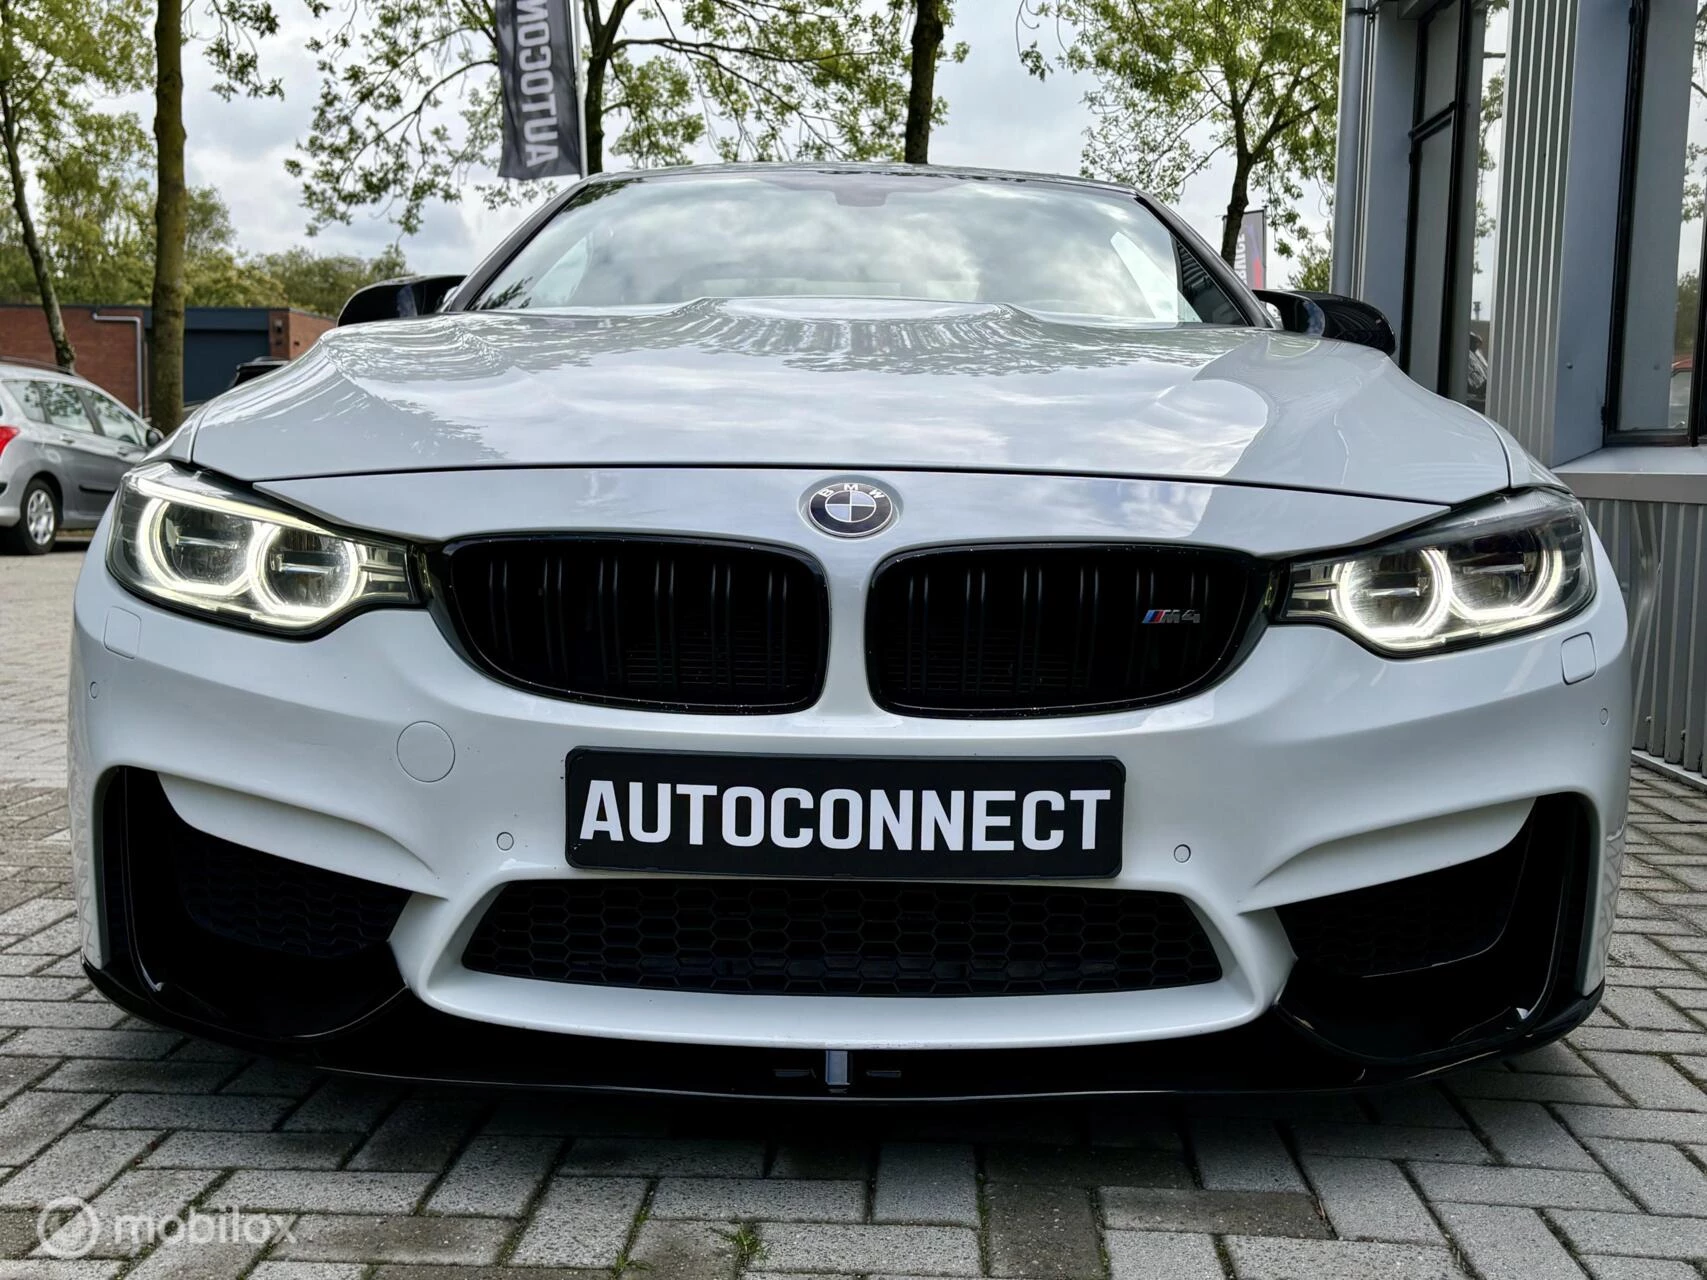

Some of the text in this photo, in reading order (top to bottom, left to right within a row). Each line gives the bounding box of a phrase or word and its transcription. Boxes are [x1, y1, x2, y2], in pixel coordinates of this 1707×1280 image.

[818, 483, 884, 498] BMW
[1160, 609, 1200, 623] M4
[580, 780, 1111, 851] AUTOCONNECT
